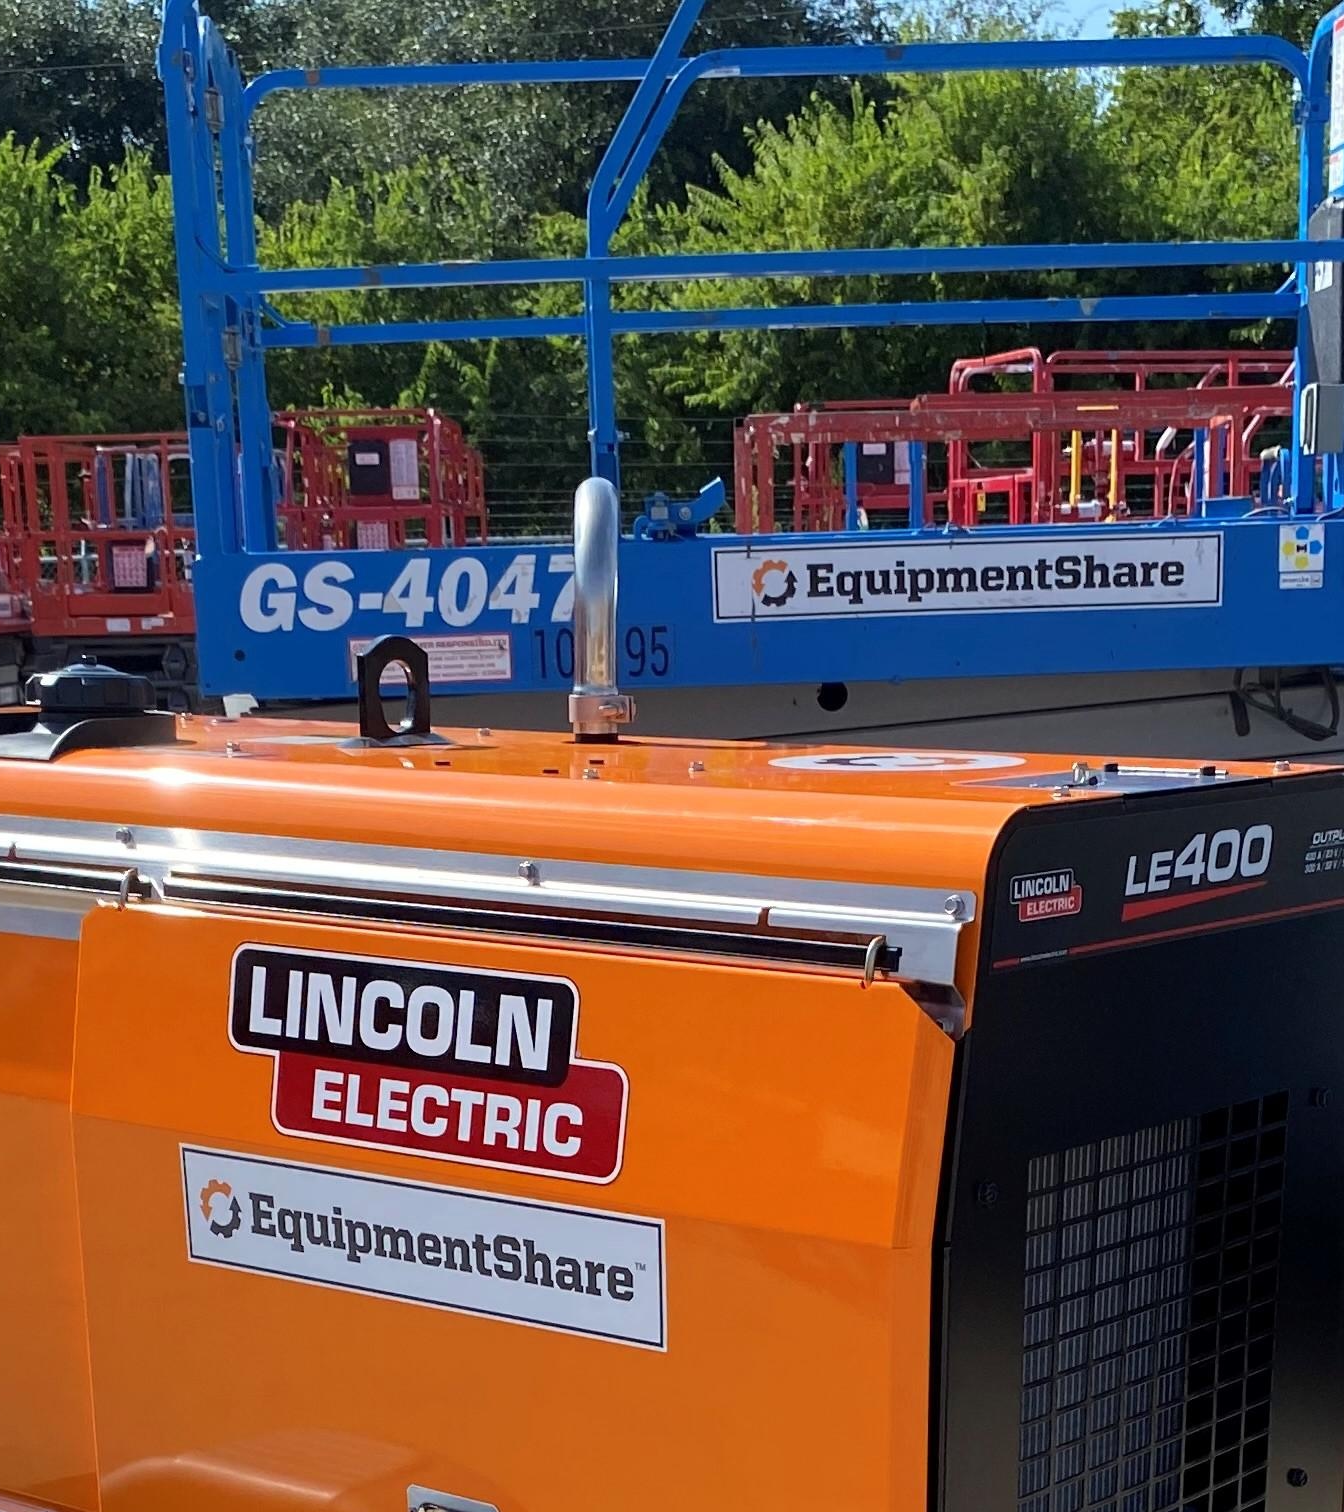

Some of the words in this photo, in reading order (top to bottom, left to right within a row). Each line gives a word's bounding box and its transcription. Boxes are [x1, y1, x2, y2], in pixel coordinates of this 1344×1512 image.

[807, 554, 1184, 604] EquipmentShare
[1014, 873, 1069, 900] LINCOLN
[1124, 824, 1274, 897] LE400
[1026, 896, 1076, 917] ELECTRIC
[248, 964, 554, 1071] LINCOLN
[311, 1068, 584, 1158] ELECTRIC
[248, 1192, 635, 1302] EquipmentShare
